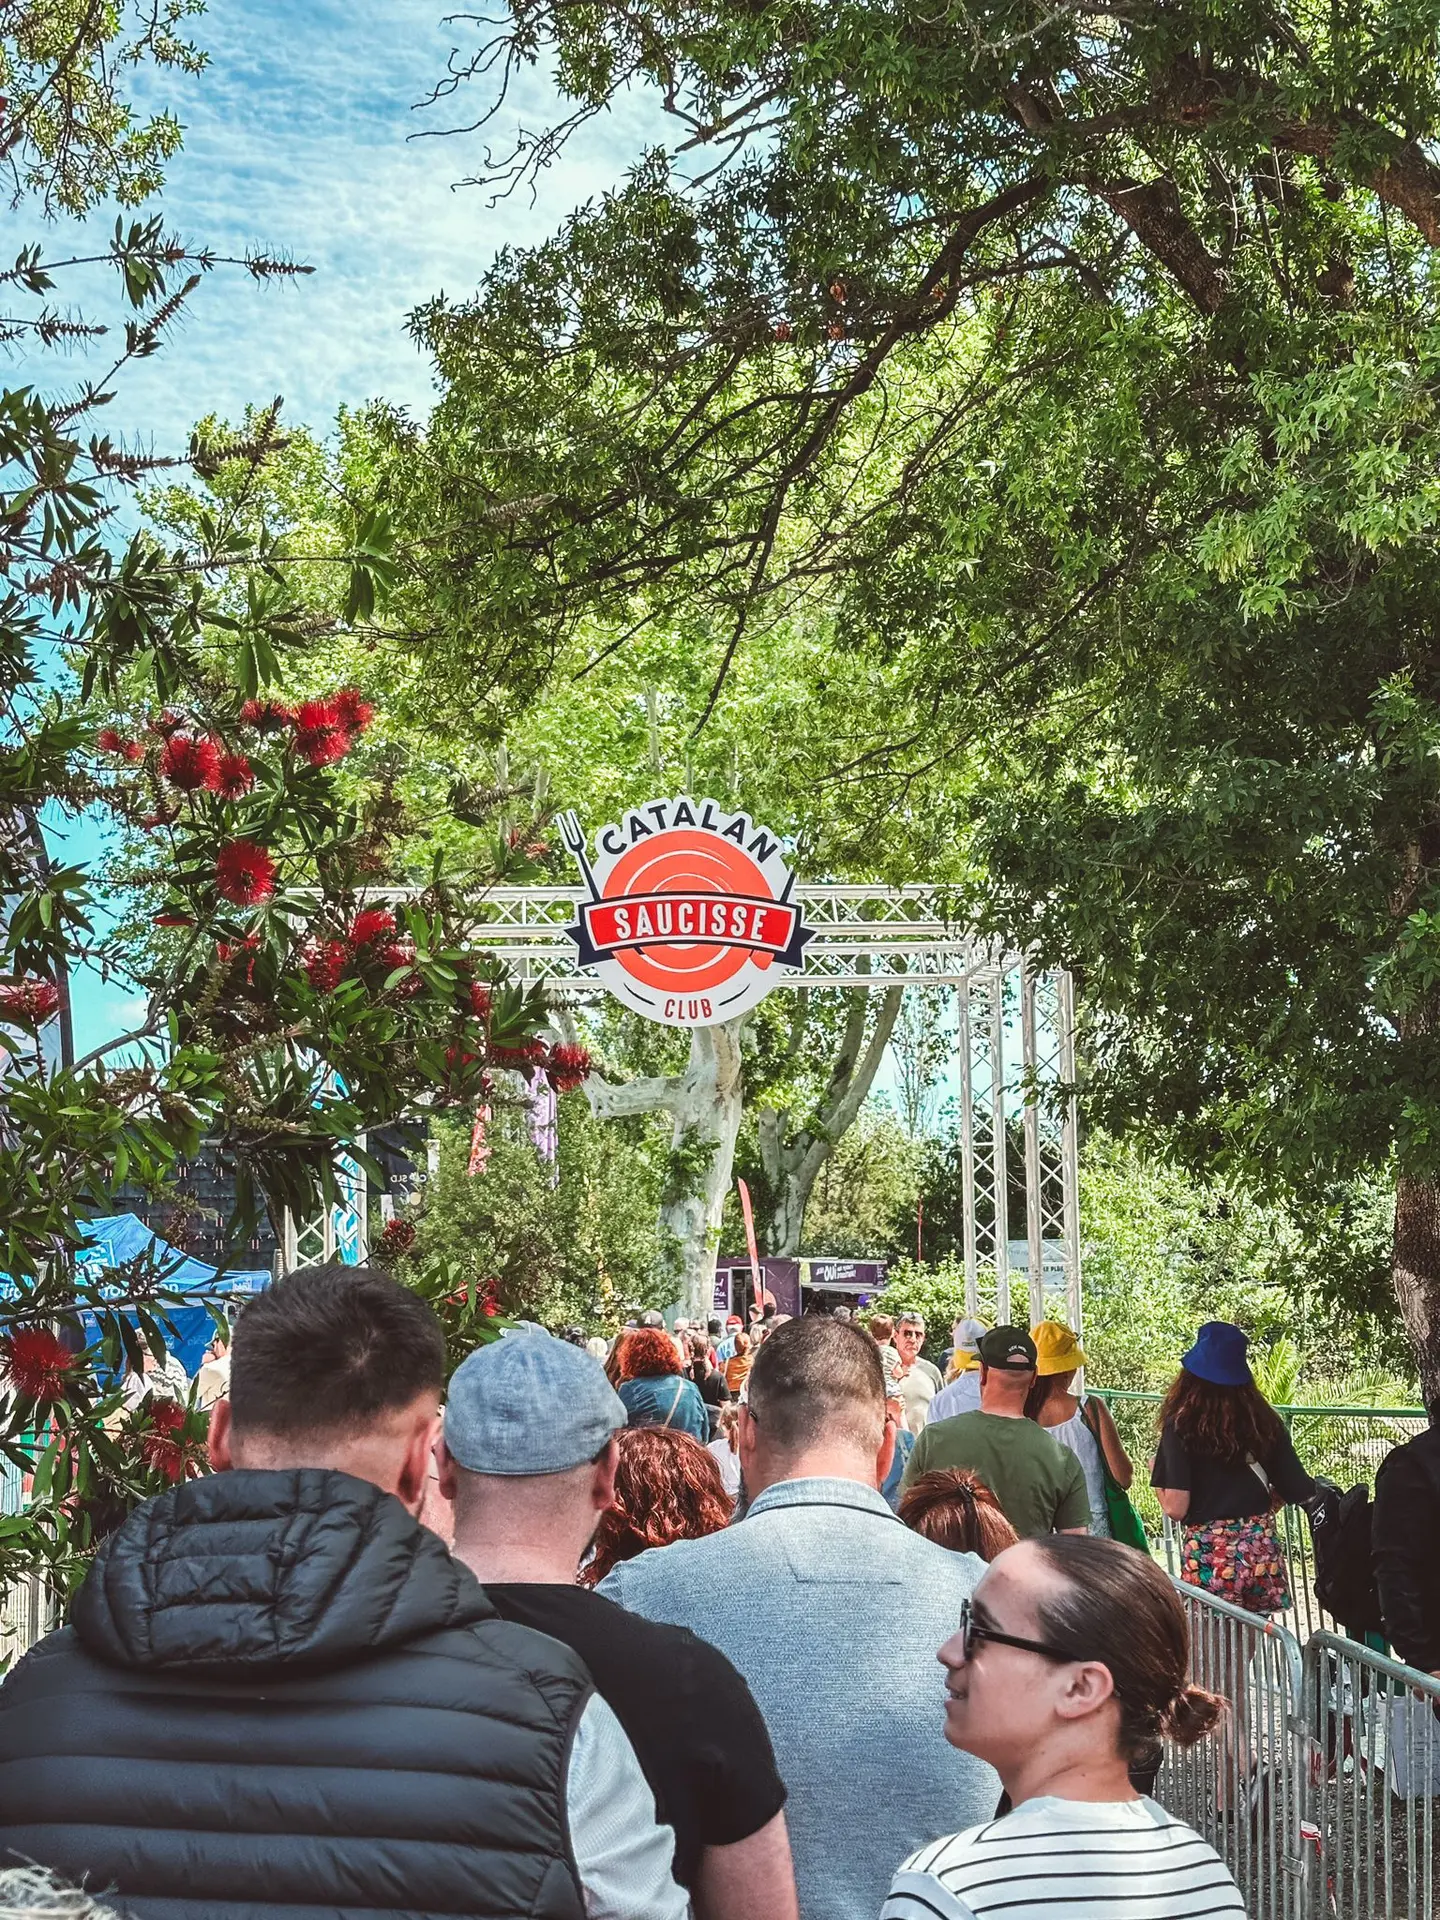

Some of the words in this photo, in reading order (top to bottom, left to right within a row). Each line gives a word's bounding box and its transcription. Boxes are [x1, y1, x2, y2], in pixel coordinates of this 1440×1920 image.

[602, 801, 778, 863] CATALAN
[613, 902, 768, 940] SAUCISSE
[664, 998, 713, 1020] CLUB
